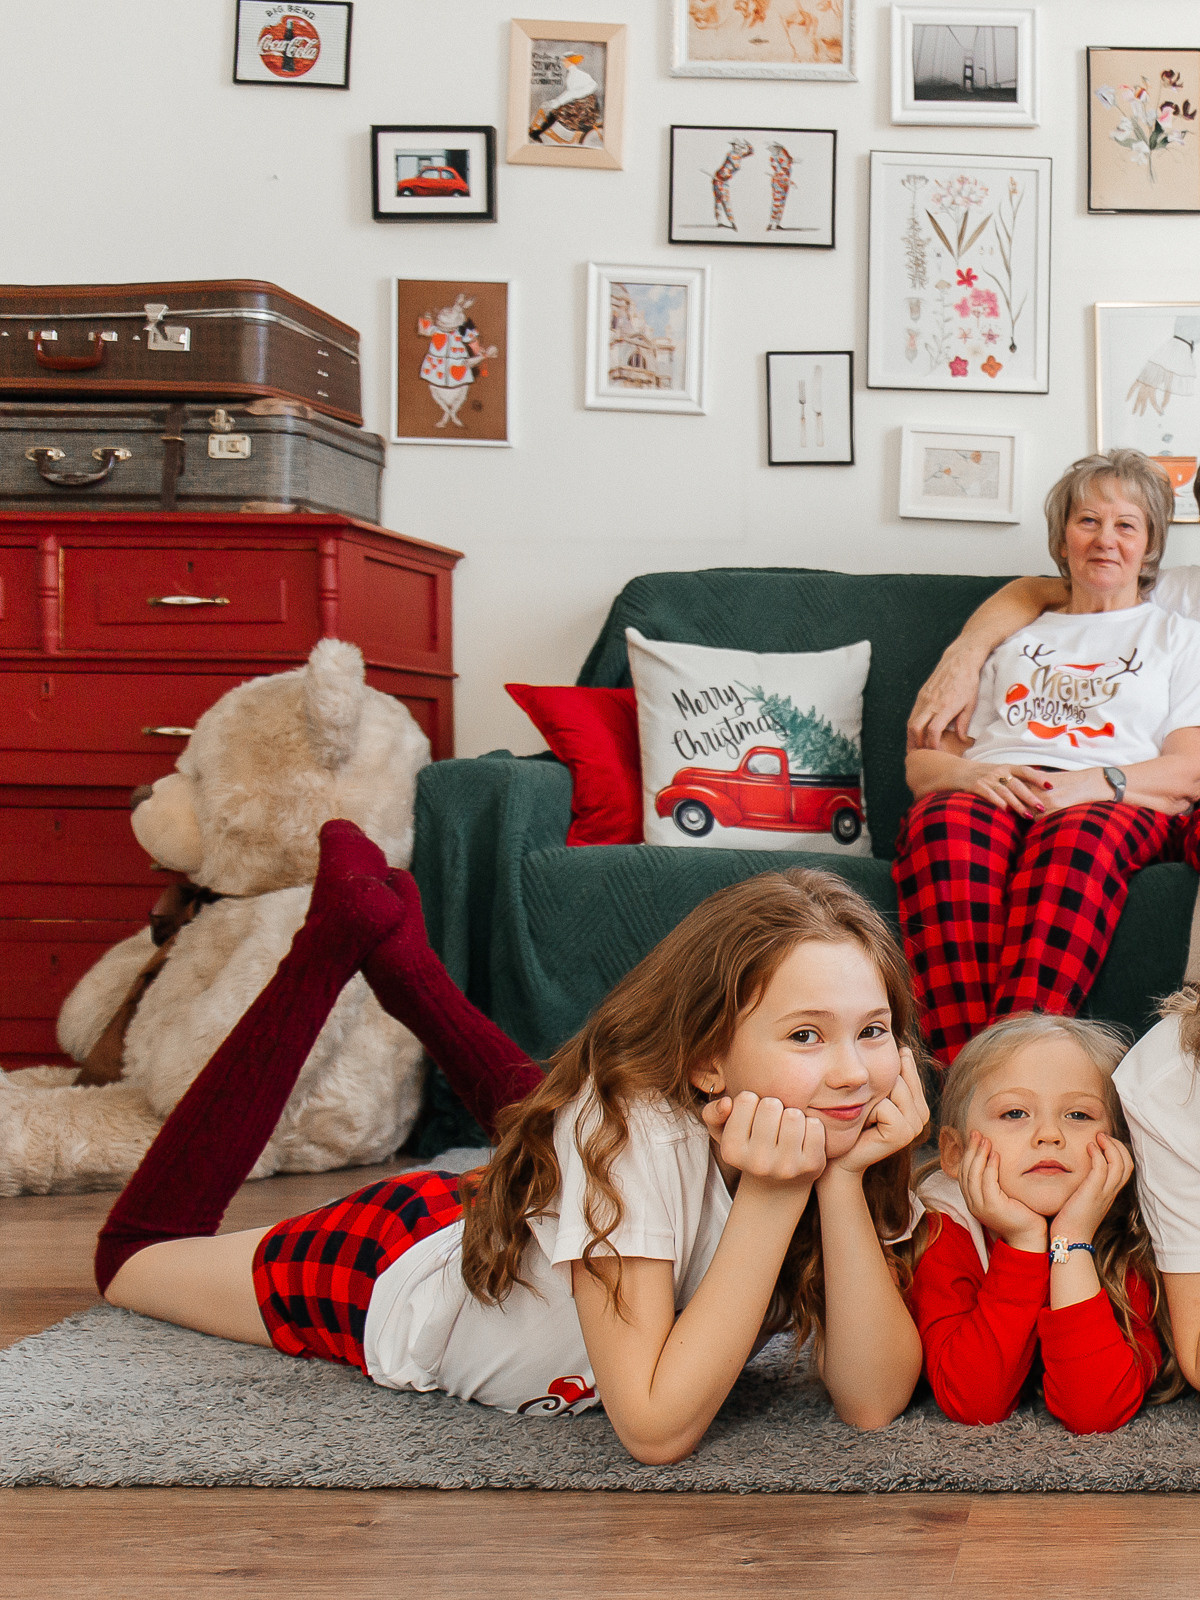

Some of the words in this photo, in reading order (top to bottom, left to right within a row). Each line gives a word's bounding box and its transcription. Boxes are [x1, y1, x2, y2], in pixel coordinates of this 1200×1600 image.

[265, 5, 284, 17] BIG
[672, 683, 746, 722] Merry
[1031, 664, 1120, 708] Merry
[672, 709, 789, 760] Christmas
